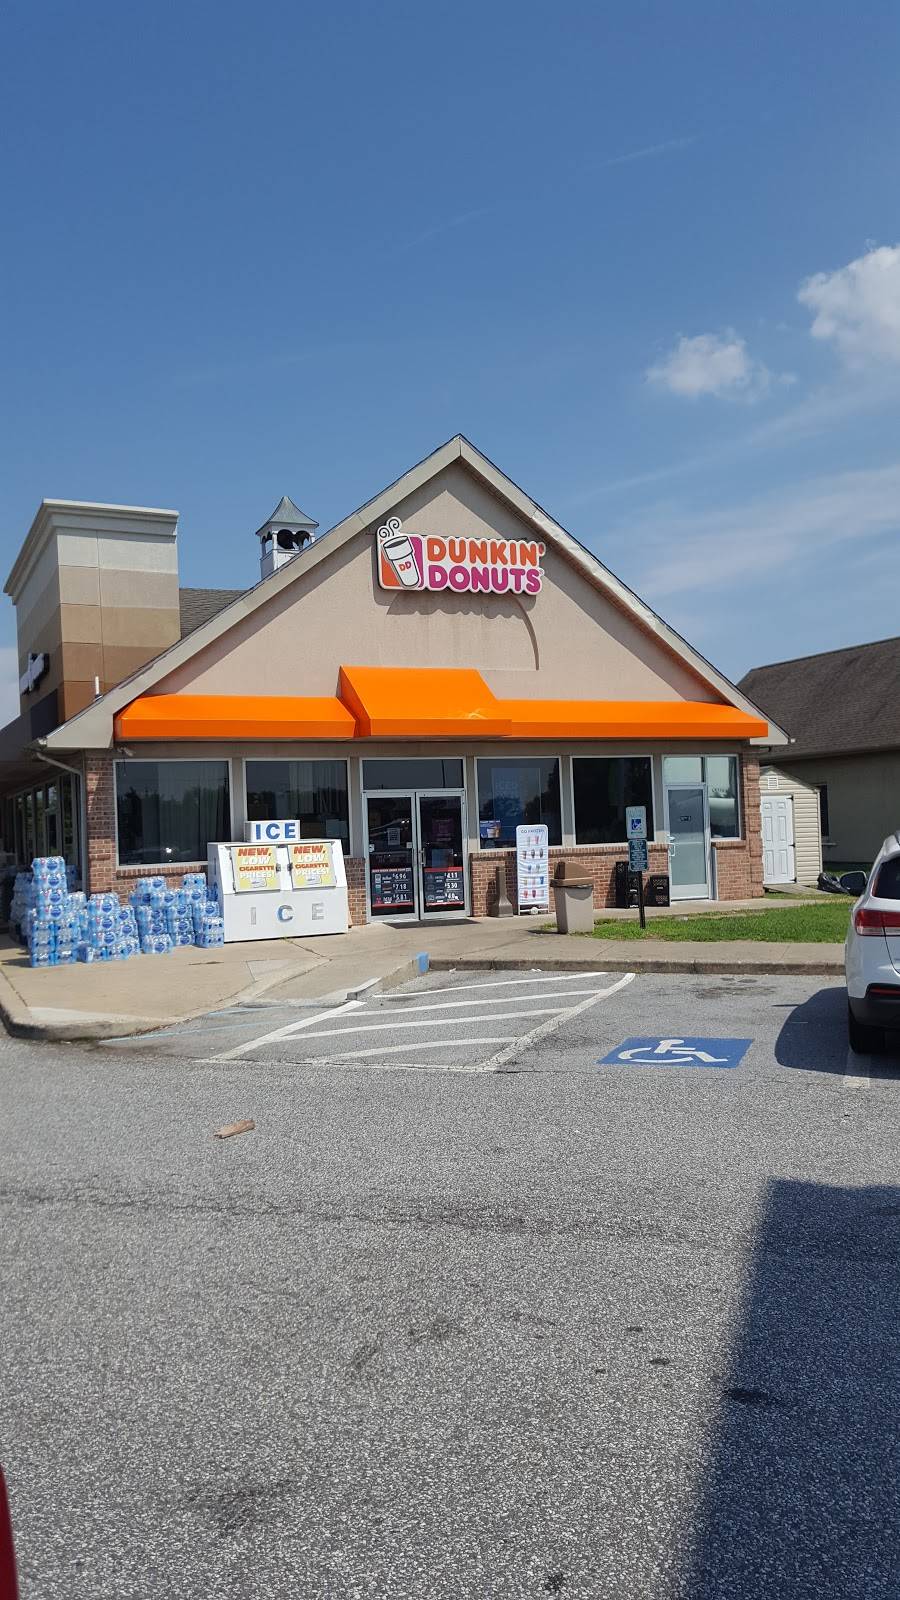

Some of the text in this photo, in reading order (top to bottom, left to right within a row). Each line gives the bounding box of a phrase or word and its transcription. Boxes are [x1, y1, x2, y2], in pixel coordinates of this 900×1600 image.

[427, 537, 545, 567] DUNKIN'
[398, 561, 412, 572] DD
[428, 565, 541, 593] DONUTS
[255, 823, 296, 840] ICE
[241, 856, 271, 865] LOW
[296, 854, 326, 863] LOW
